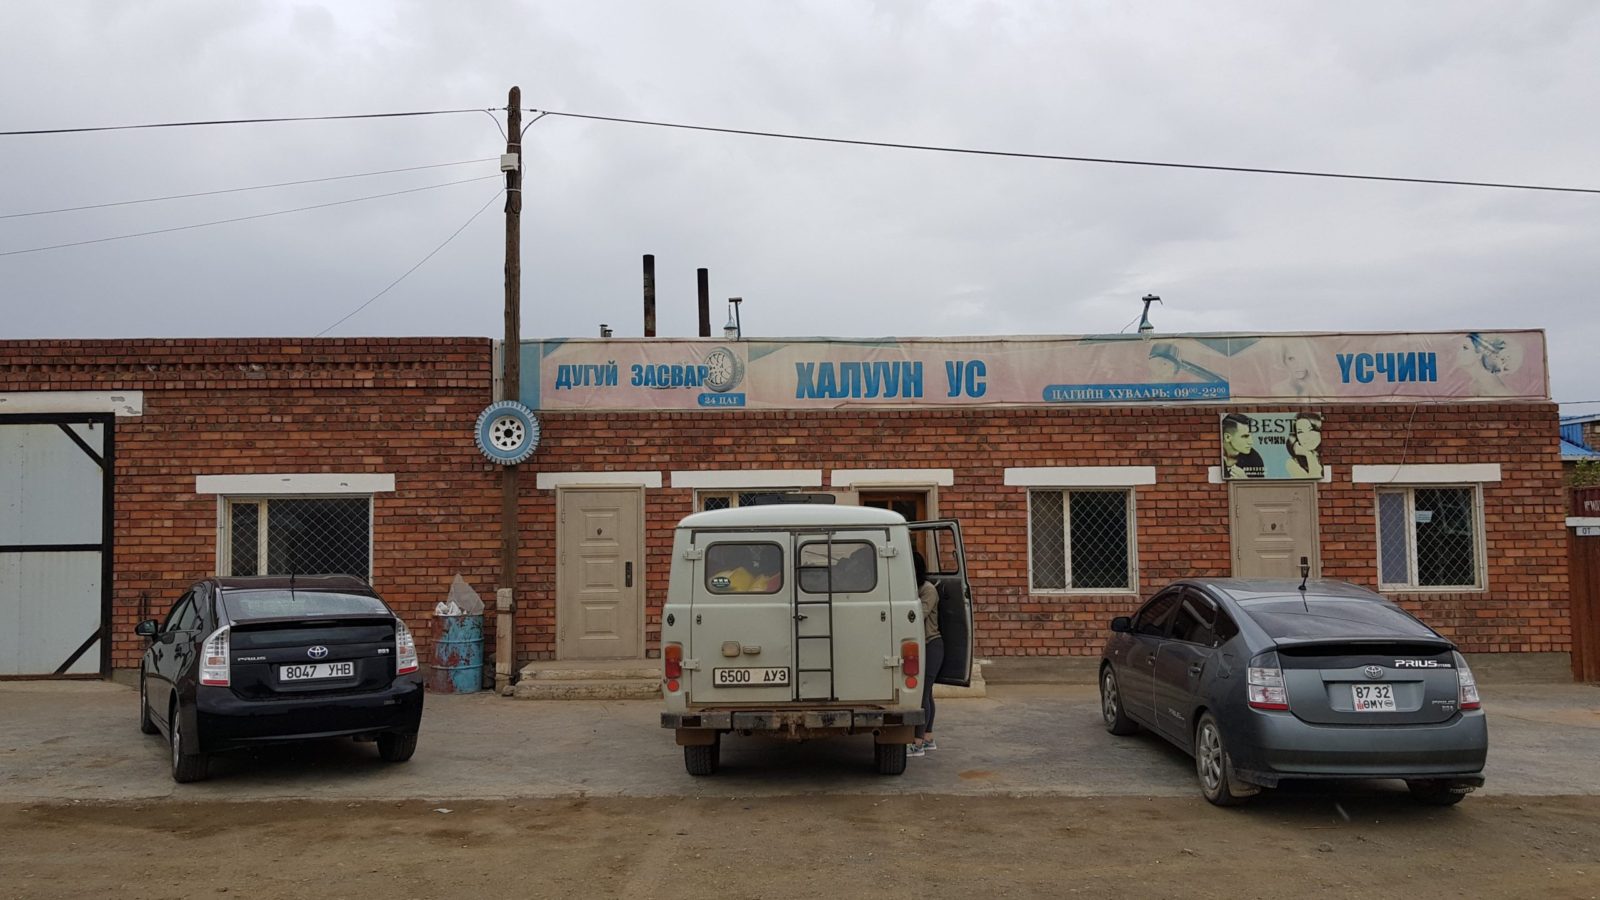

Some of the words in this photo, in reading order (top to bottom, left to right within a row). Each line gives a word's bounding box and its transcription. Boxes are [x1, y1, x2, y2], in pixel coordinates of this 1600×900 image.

[555, 360, 618, 390] ДУГУЙ
[631, 364, 710, 388] ЗАСВАР
[1336, 352, 1438, 384] ҮСЧИН
[795, 361, 924, 399] ХАЛУУН
[945, 360, 987, 398] УС
[1052, 388, 1103, 401] ЦАГИЙН
[1248, 418, 1297, 433] BEST
[286, 665, 317, 679] 8047
[328, 663, 351, 676] УНВ
[720, 669, 751, 683] 6500
